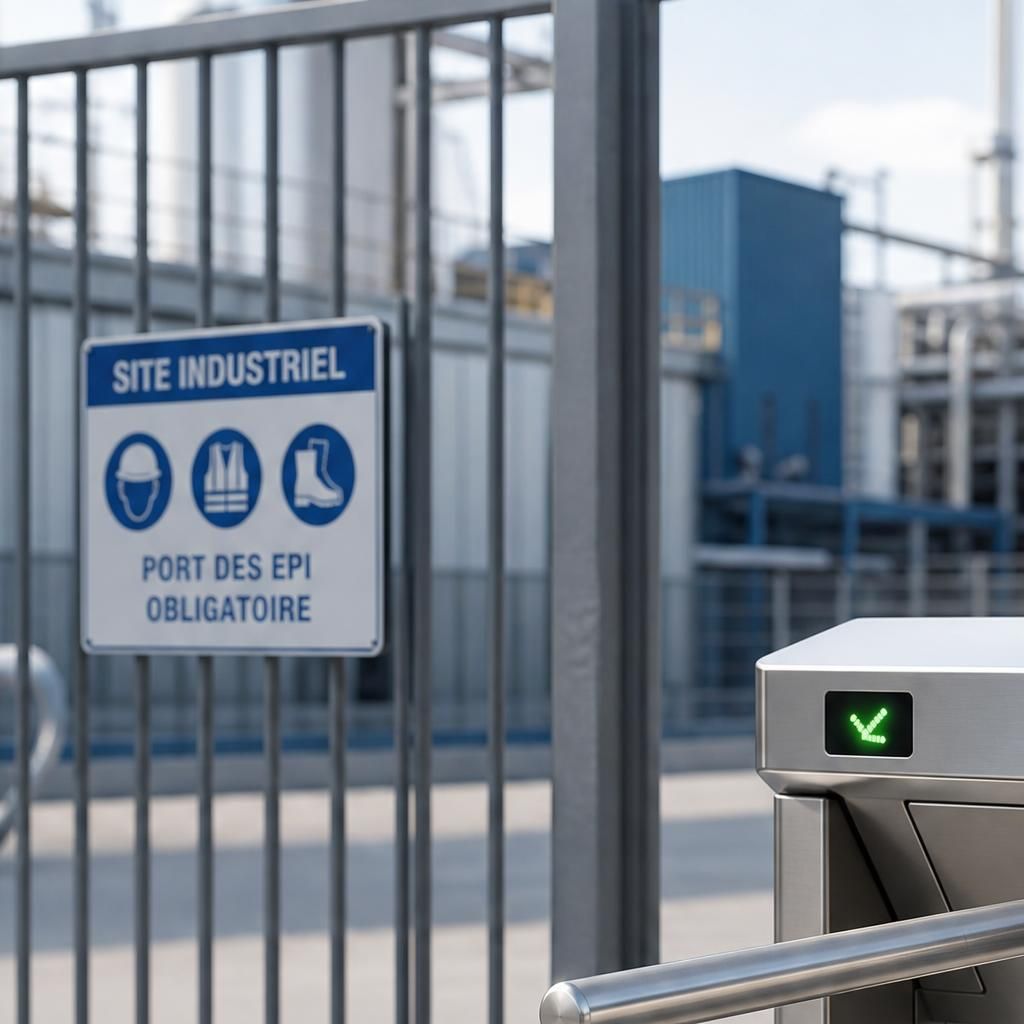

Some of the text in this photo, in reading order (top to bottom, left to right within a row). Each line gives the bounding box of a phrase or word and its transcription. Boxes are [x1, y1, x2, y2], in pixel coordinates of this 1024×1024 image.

[112, 346, 346, 394] SITE INDUSTRIEL
[142, 553, 312, 582] PORT DES EPI
[146, 596, 312, 622] OBLIGATOIRE
